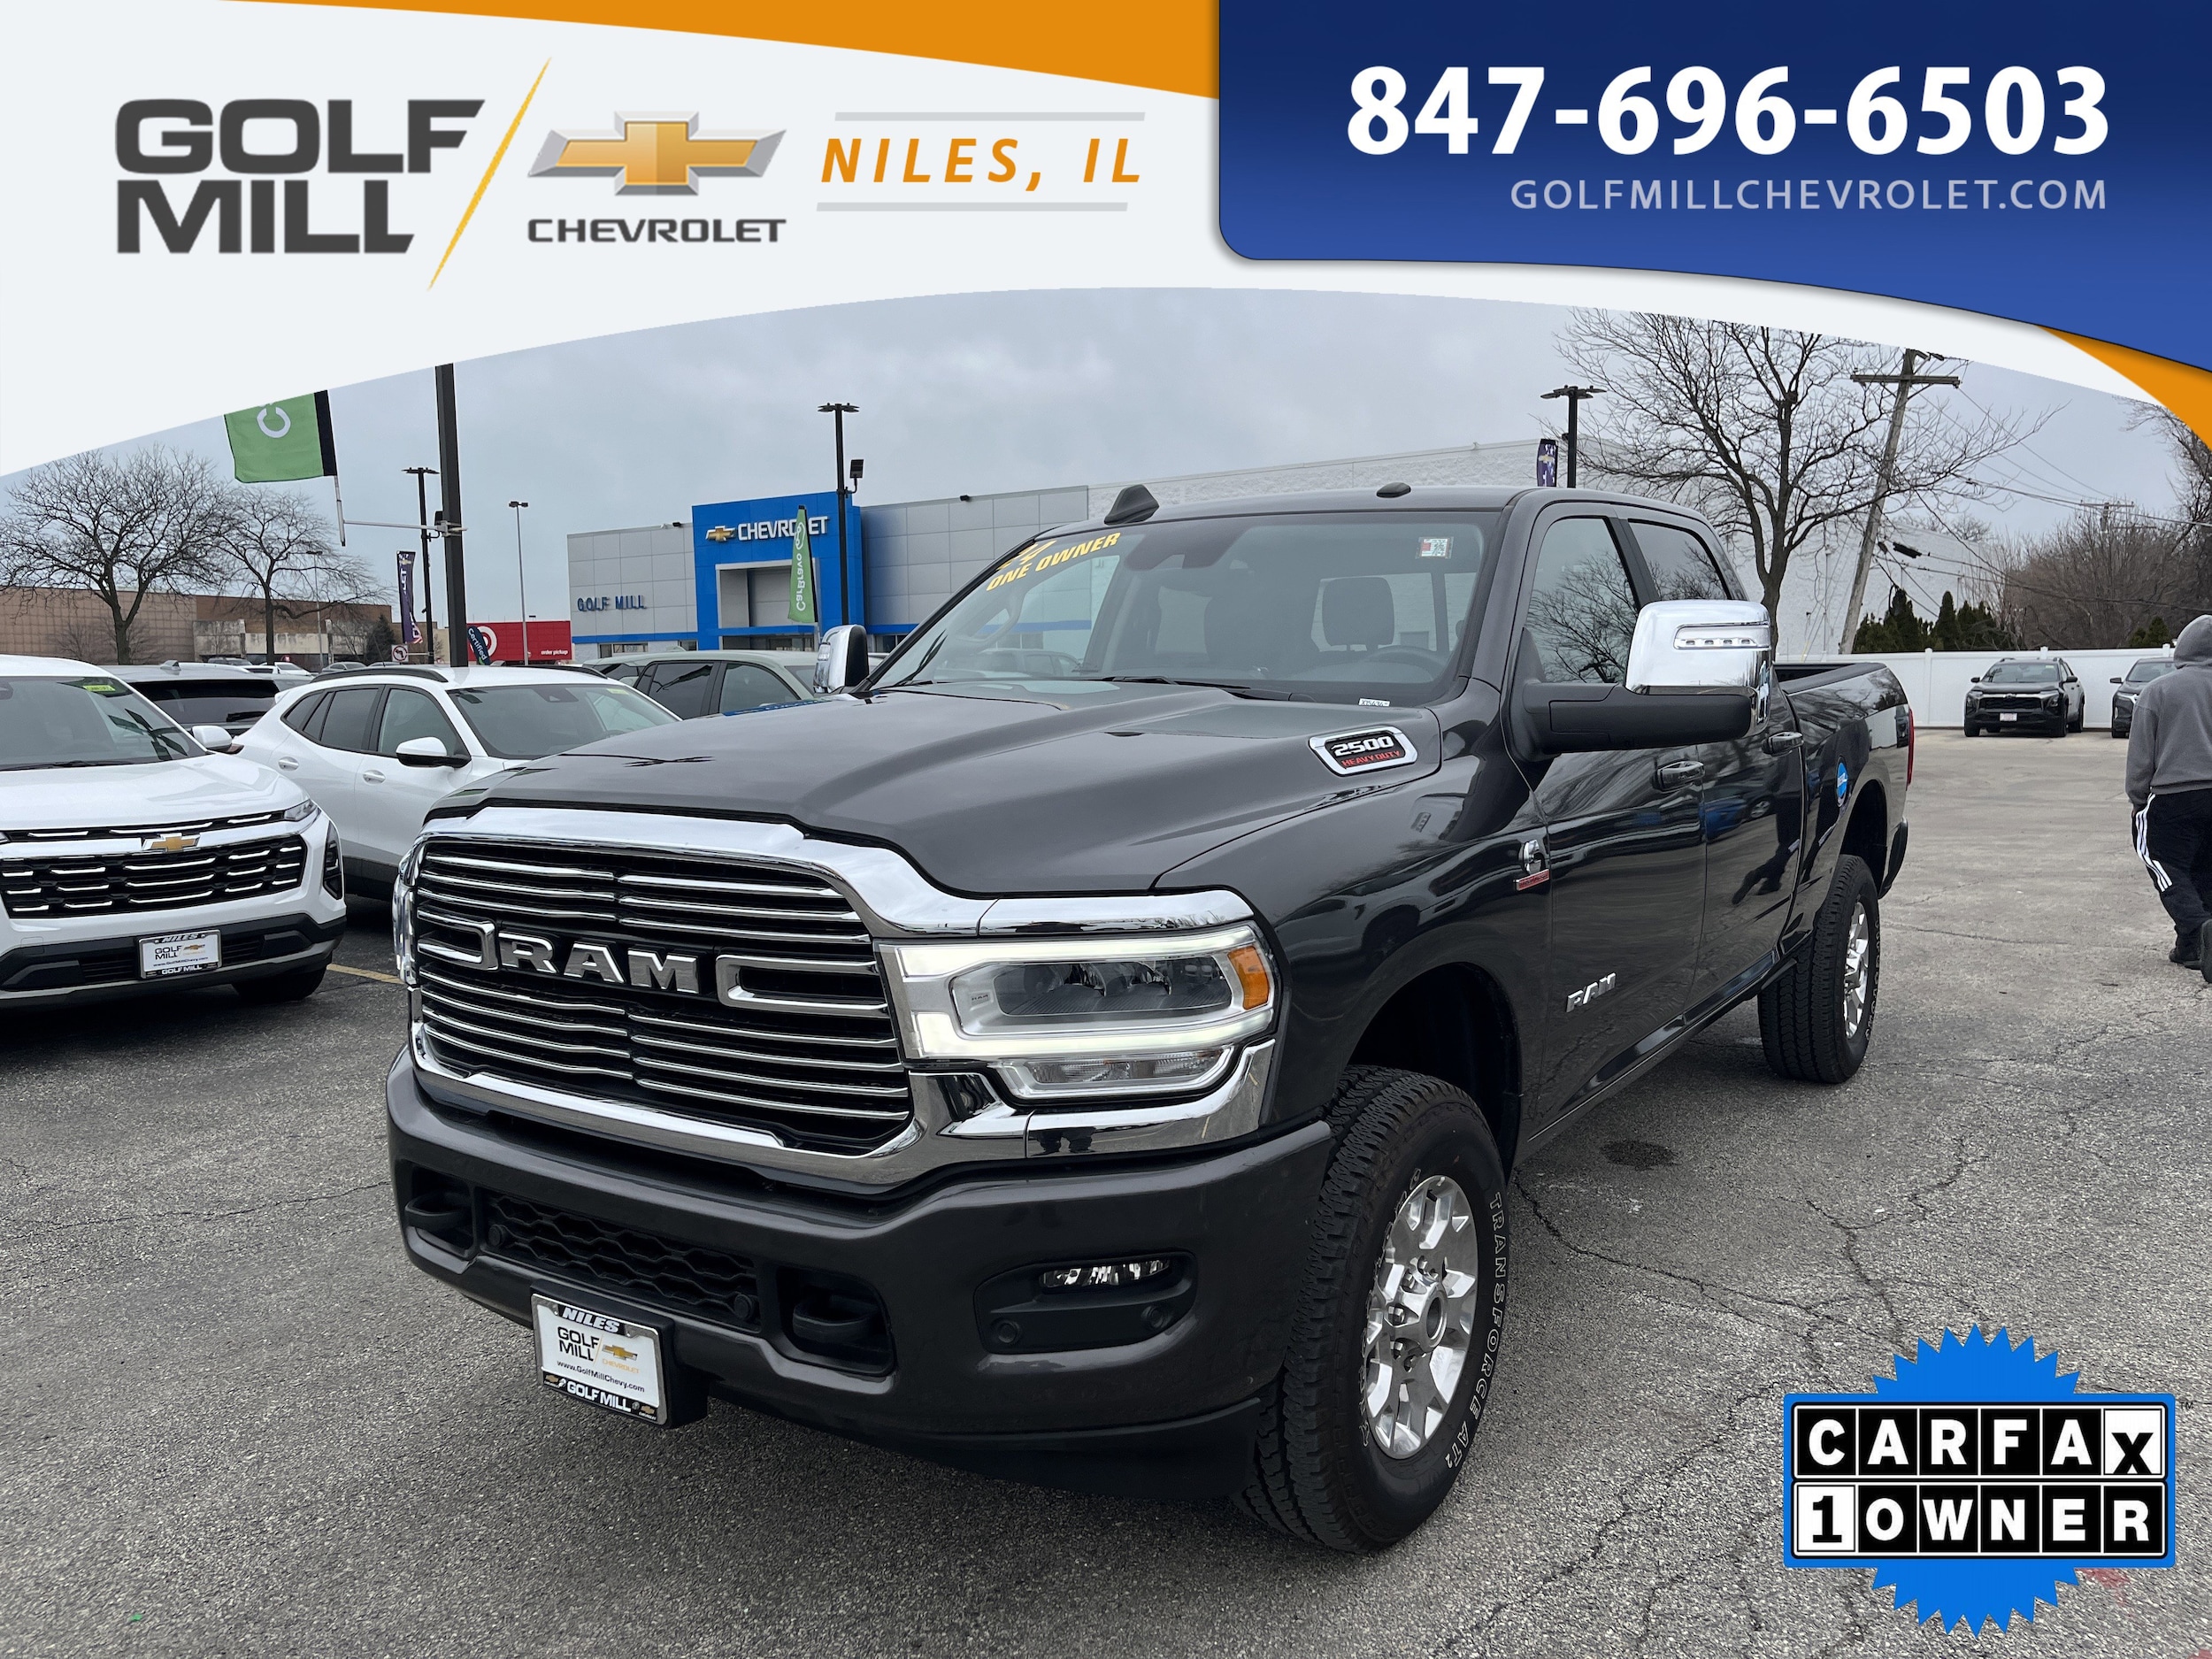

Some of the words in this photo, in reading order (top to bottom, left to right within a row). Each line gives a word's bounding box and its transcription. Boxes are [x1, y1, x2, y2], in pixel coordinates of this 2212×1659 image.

[738, 516, 829, 541] CHEVROET
[987, 563, 1033, 592] ONE
[1035, 533, 1121, 572] OWNER
[577, 596, 610, 611] GOLF
[615, 595, 647, 610] MILL
[468, 627, 488, 661] Certified
[1331, 735, 1394, 757] 2500
[1341, 755, 1374, 766] HEAVY
[1375, 750, 1401, 760] DUTY
[154, 945, 182, 955] GOLF
[161, 933, 199, 943] NILES
[498, 932, 700, 995] RAM
[1566, 972, 1617, 1013] RAM
[1469, 1192, 1506, 1419] TRANSFORCE
[563, 1307, 619, 1333] NILES
[557, 1326, 600, 1349] GOLF
[559, 1340, 595, 1362] MILL
[557, 1360, 645, 1393] www.GolfMillChevy.com
[566, 1380, 599, 1402] GOLF
[600, 1392, 632, 1413] MILL
